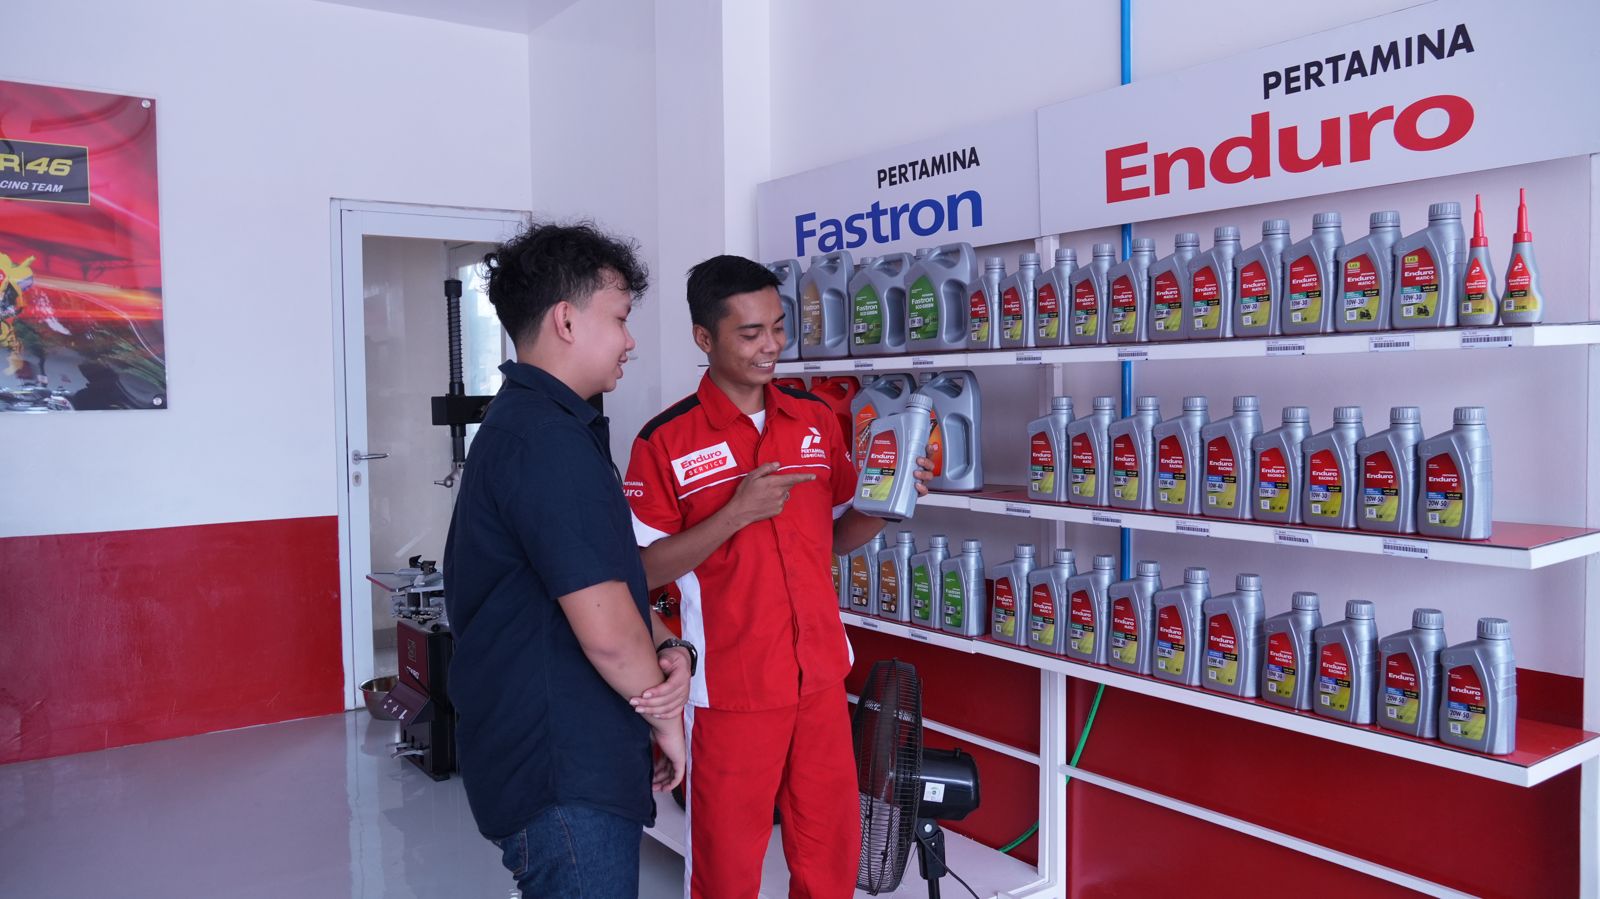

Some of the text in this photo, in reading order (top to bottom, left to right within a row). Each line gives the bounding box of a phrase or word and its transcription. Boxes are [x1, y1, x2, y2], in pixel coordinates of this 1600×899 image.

[1262, 23, 1475, 100] PERTAMINA
[1105, 94, 1475, 204] Enduro
[877, 146, 980, 189] PERTAMINA
[31, 182, 64, 193] TEAM
[795, 189, 983, 257] Fastron
[1292, 277, 1317, 285] Enduro
[911, 297, 934, 305] Fastron
[856, 304, 878, 312] Fastron
[680, 450, 722, 469] Enduro
[688, 459, 724, 477] SERVICE
[623, 489, 643, 497] uro
[1033, 602, 1052, 610] Enduro
[1072, 610, 1092, 618] Enduro
[1114, 618, 1134, 626] Enduro
[1160, 627, 1182, 635] Enduro
[1210, 636, 1234, 644] Enduro
[1270, 650, 1292, 659] Enduro
[1322, 662, 1347, 671] Enduro
[1388, 673, 1415, 682] Enduro
[1451, 686, 1481, 696] Enduro
[1387, 695, 1405, 704] 20W-50
[1449, 710, 1470, 719] 20W-50
